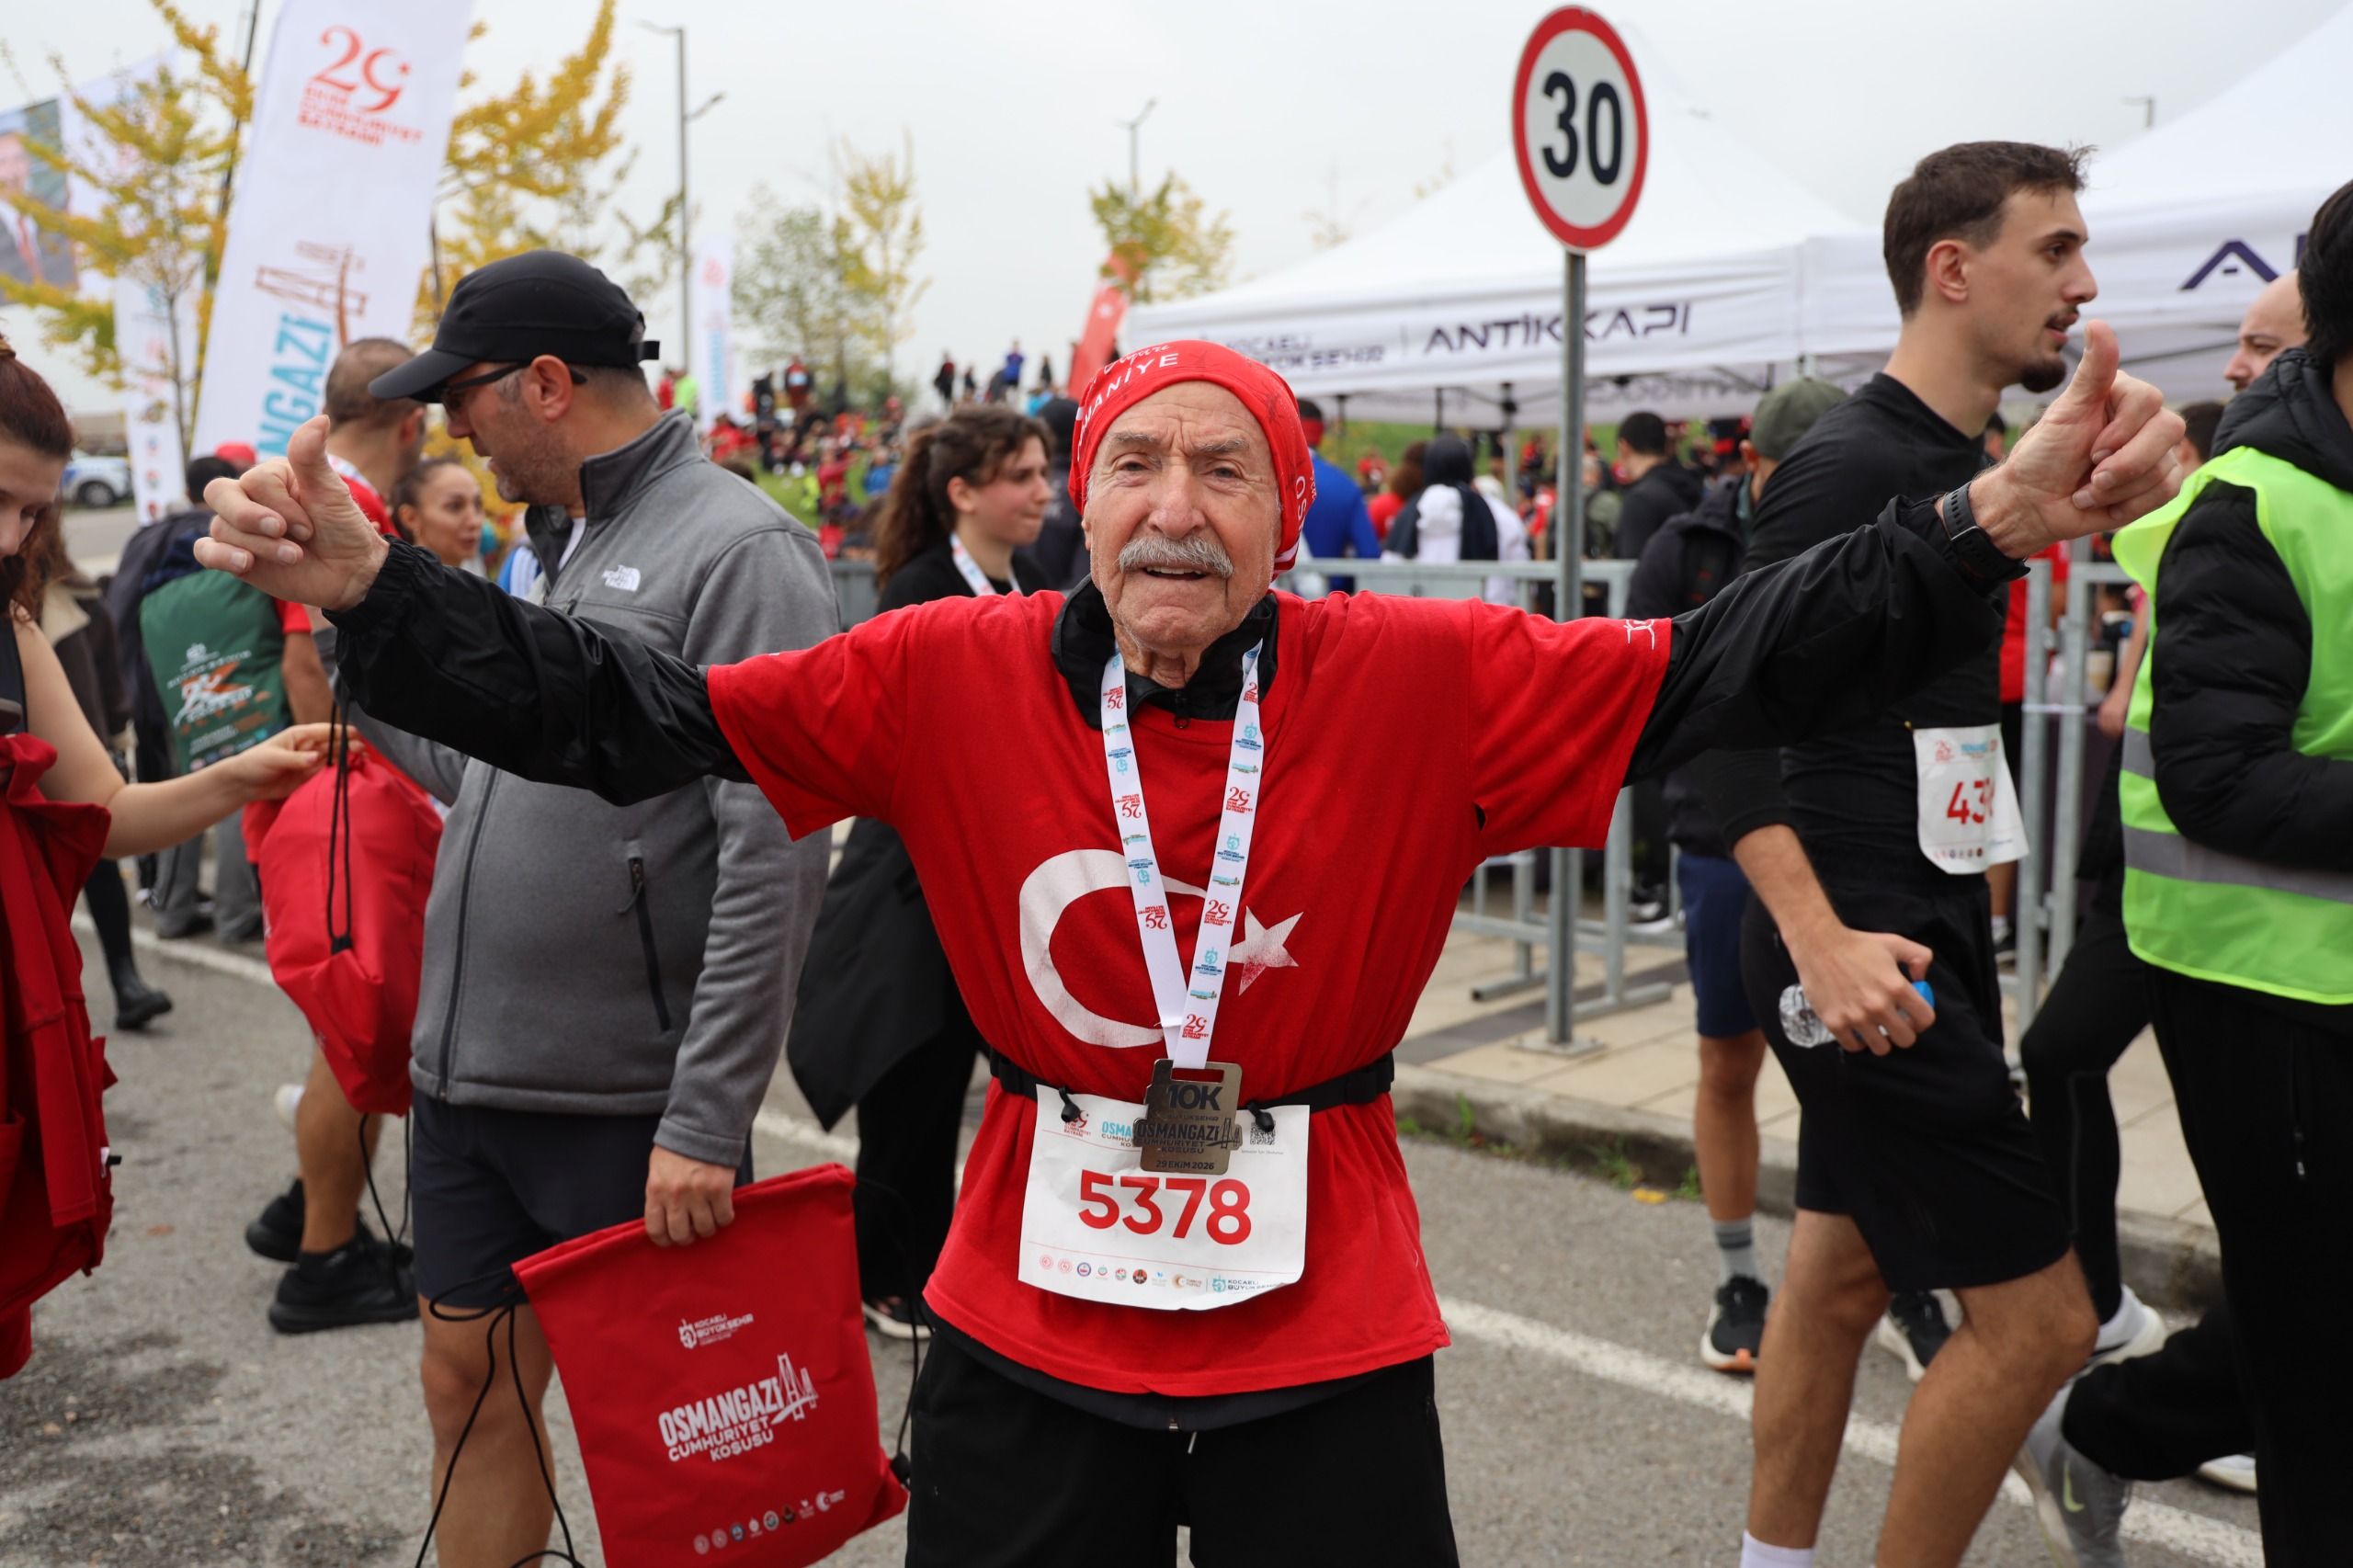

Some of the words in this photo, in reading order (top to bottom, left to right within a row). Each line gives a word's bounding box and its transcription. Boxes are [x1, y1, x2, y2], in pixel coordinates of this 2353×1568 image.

[1542, 71, 1622, 186] 30
[1167, 1084, 1223, 1111] 10K
[1078, 1169, 1251, 1245] 5378
